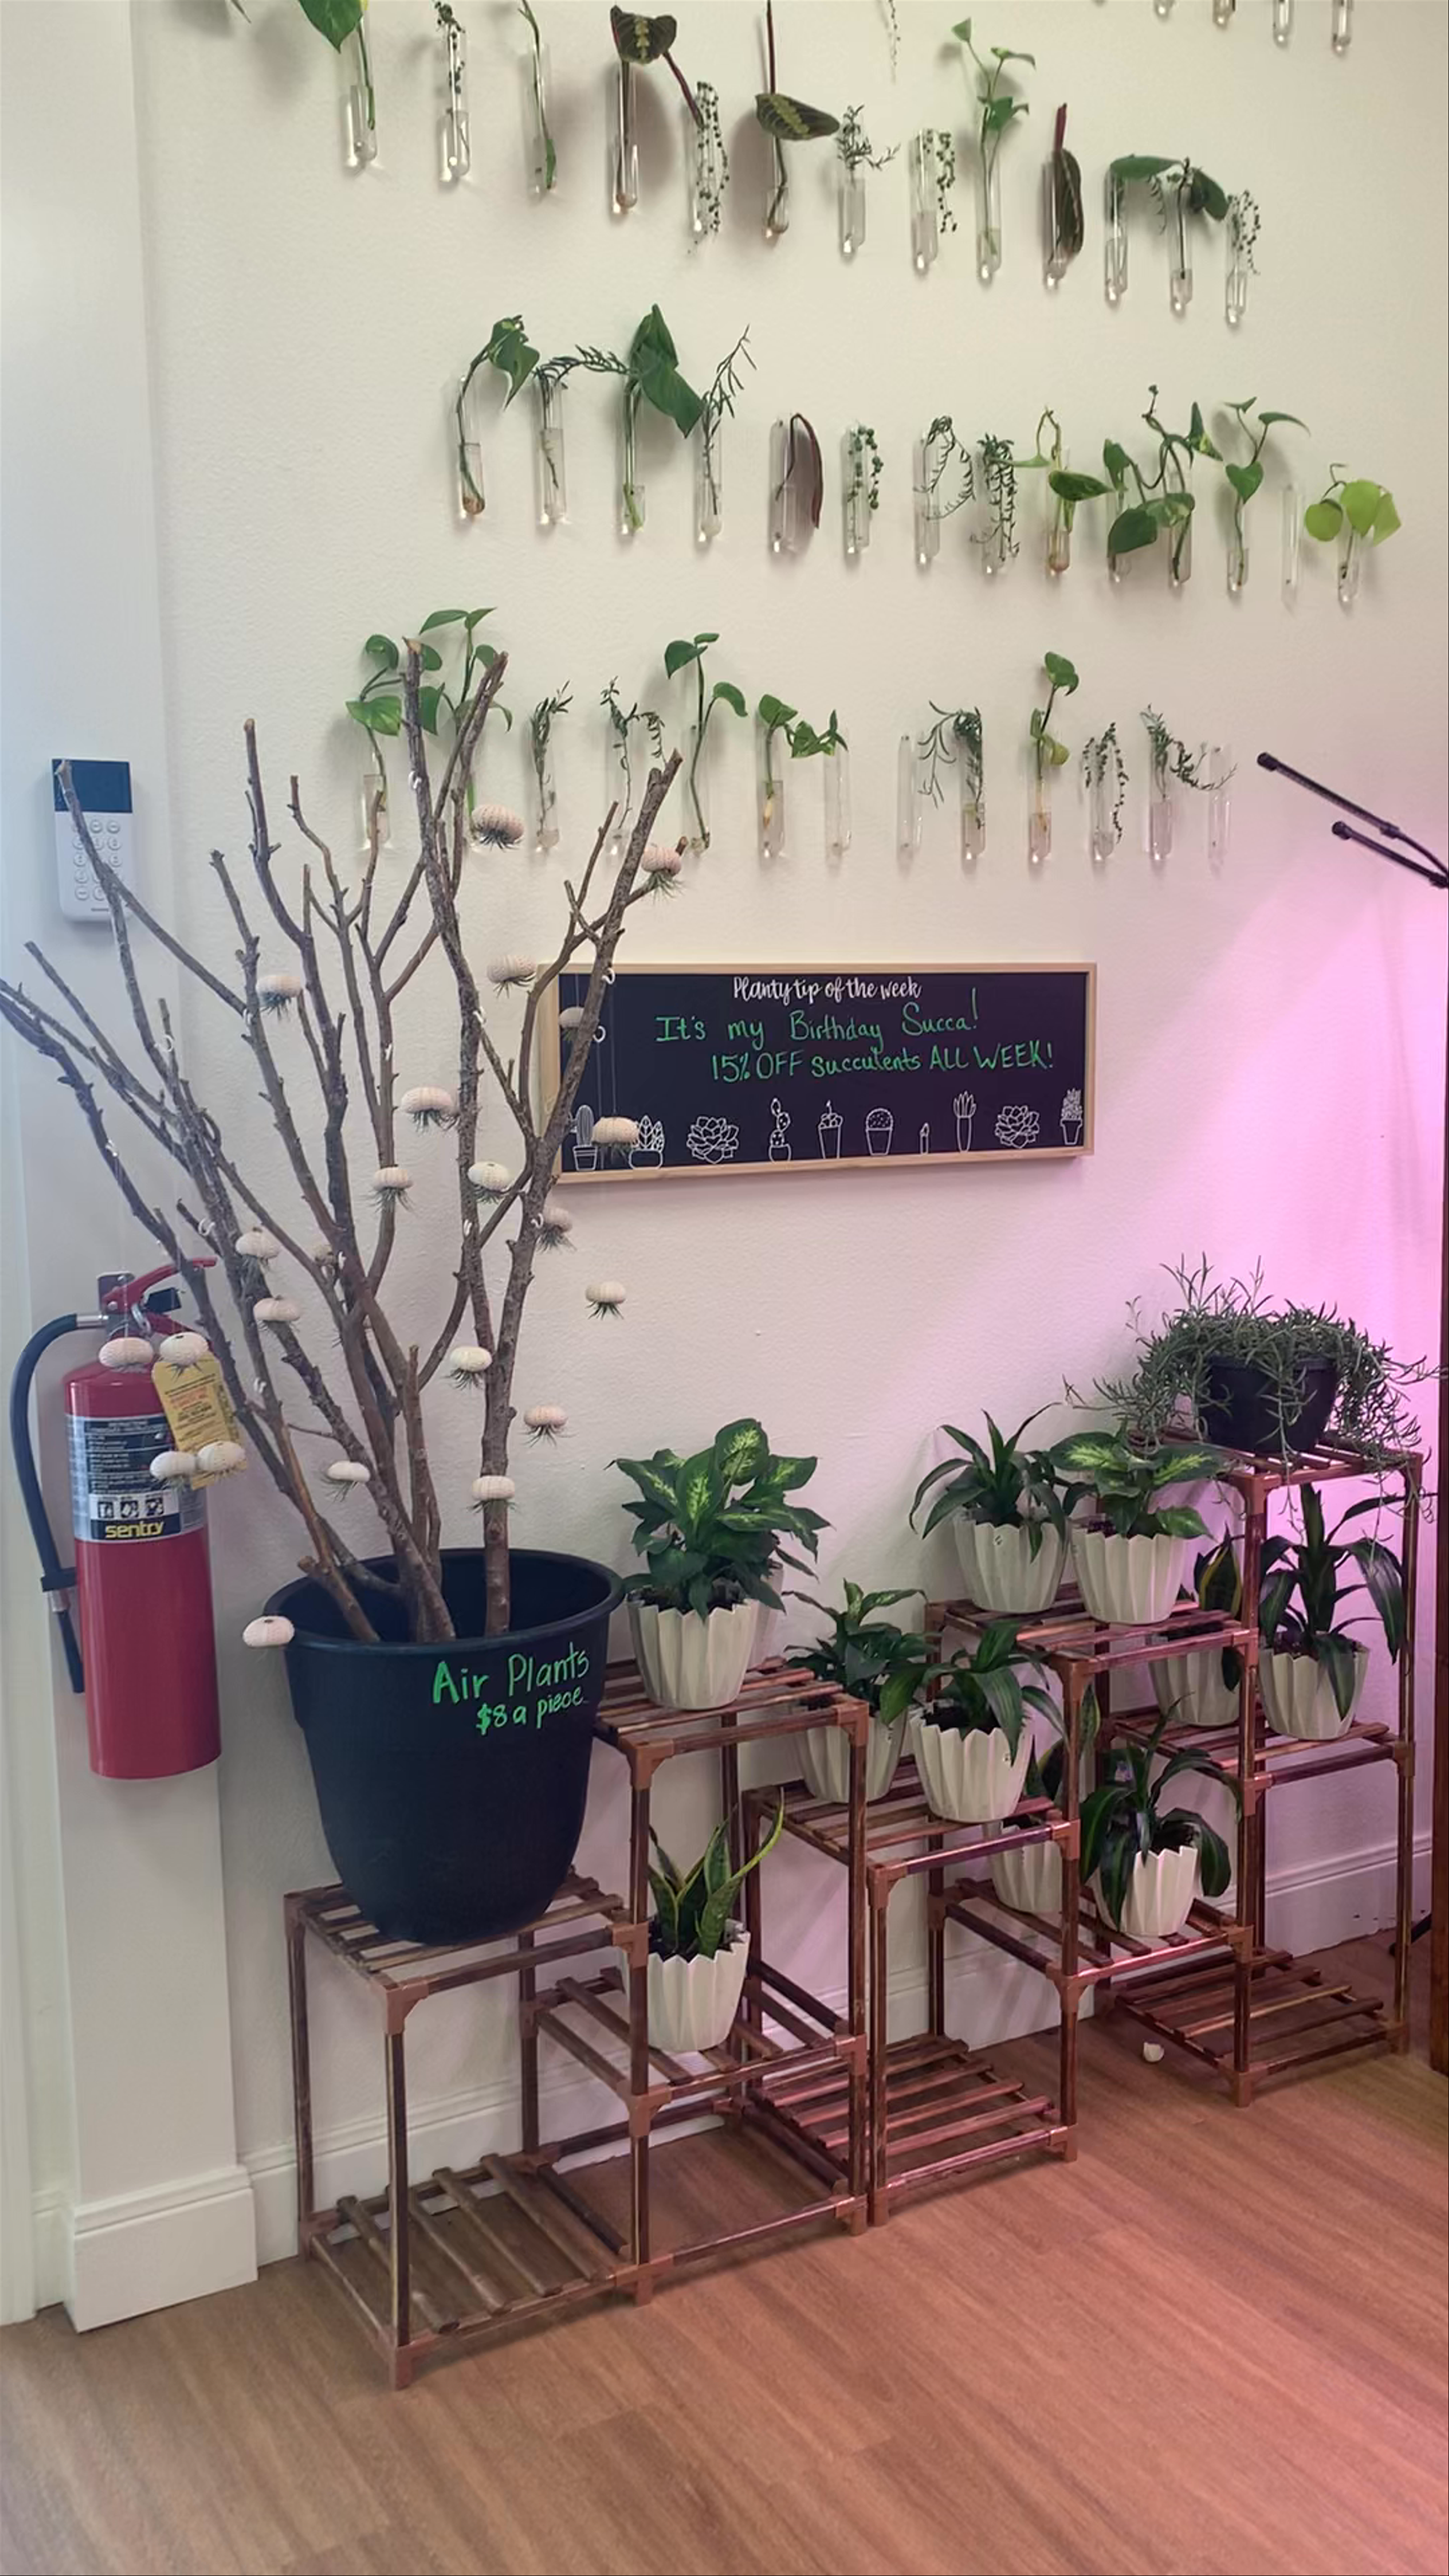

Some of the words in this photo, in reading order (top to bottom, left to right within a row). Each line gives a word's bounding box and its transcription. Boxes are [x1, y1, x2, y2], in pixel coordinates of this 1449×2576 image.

[734, 977, 792, 1006] Planty
[792, 979, 823, 1004] tip
[824, 977, 845, 1003] of
[846, 977, 878, 998] the
[880, 976, 922, 1000] week
[656, 1016, 706, 1042] It's
[728, 1020, 764, 1050] my
[790, 1010, 884, 1054] Birthday
[901, 987, 978, 1036] Succa!
[711, 1053, 751, 1082] 15%
[756, 1050, 804, 1079] OFF
[929, 1044, 969, 1071] ALL
[973, 1039, 1054, 1070] WEEK!
[105, 1521, 164, 1538] sentry
[433, 1661, 489, 1704] Air
[508, 1642, 589, 1696] Plants
[476, 1703, 508, 1735] $8
[513, 1705, 527, 1725] a
[536, 1687, 583, 1729] piece
